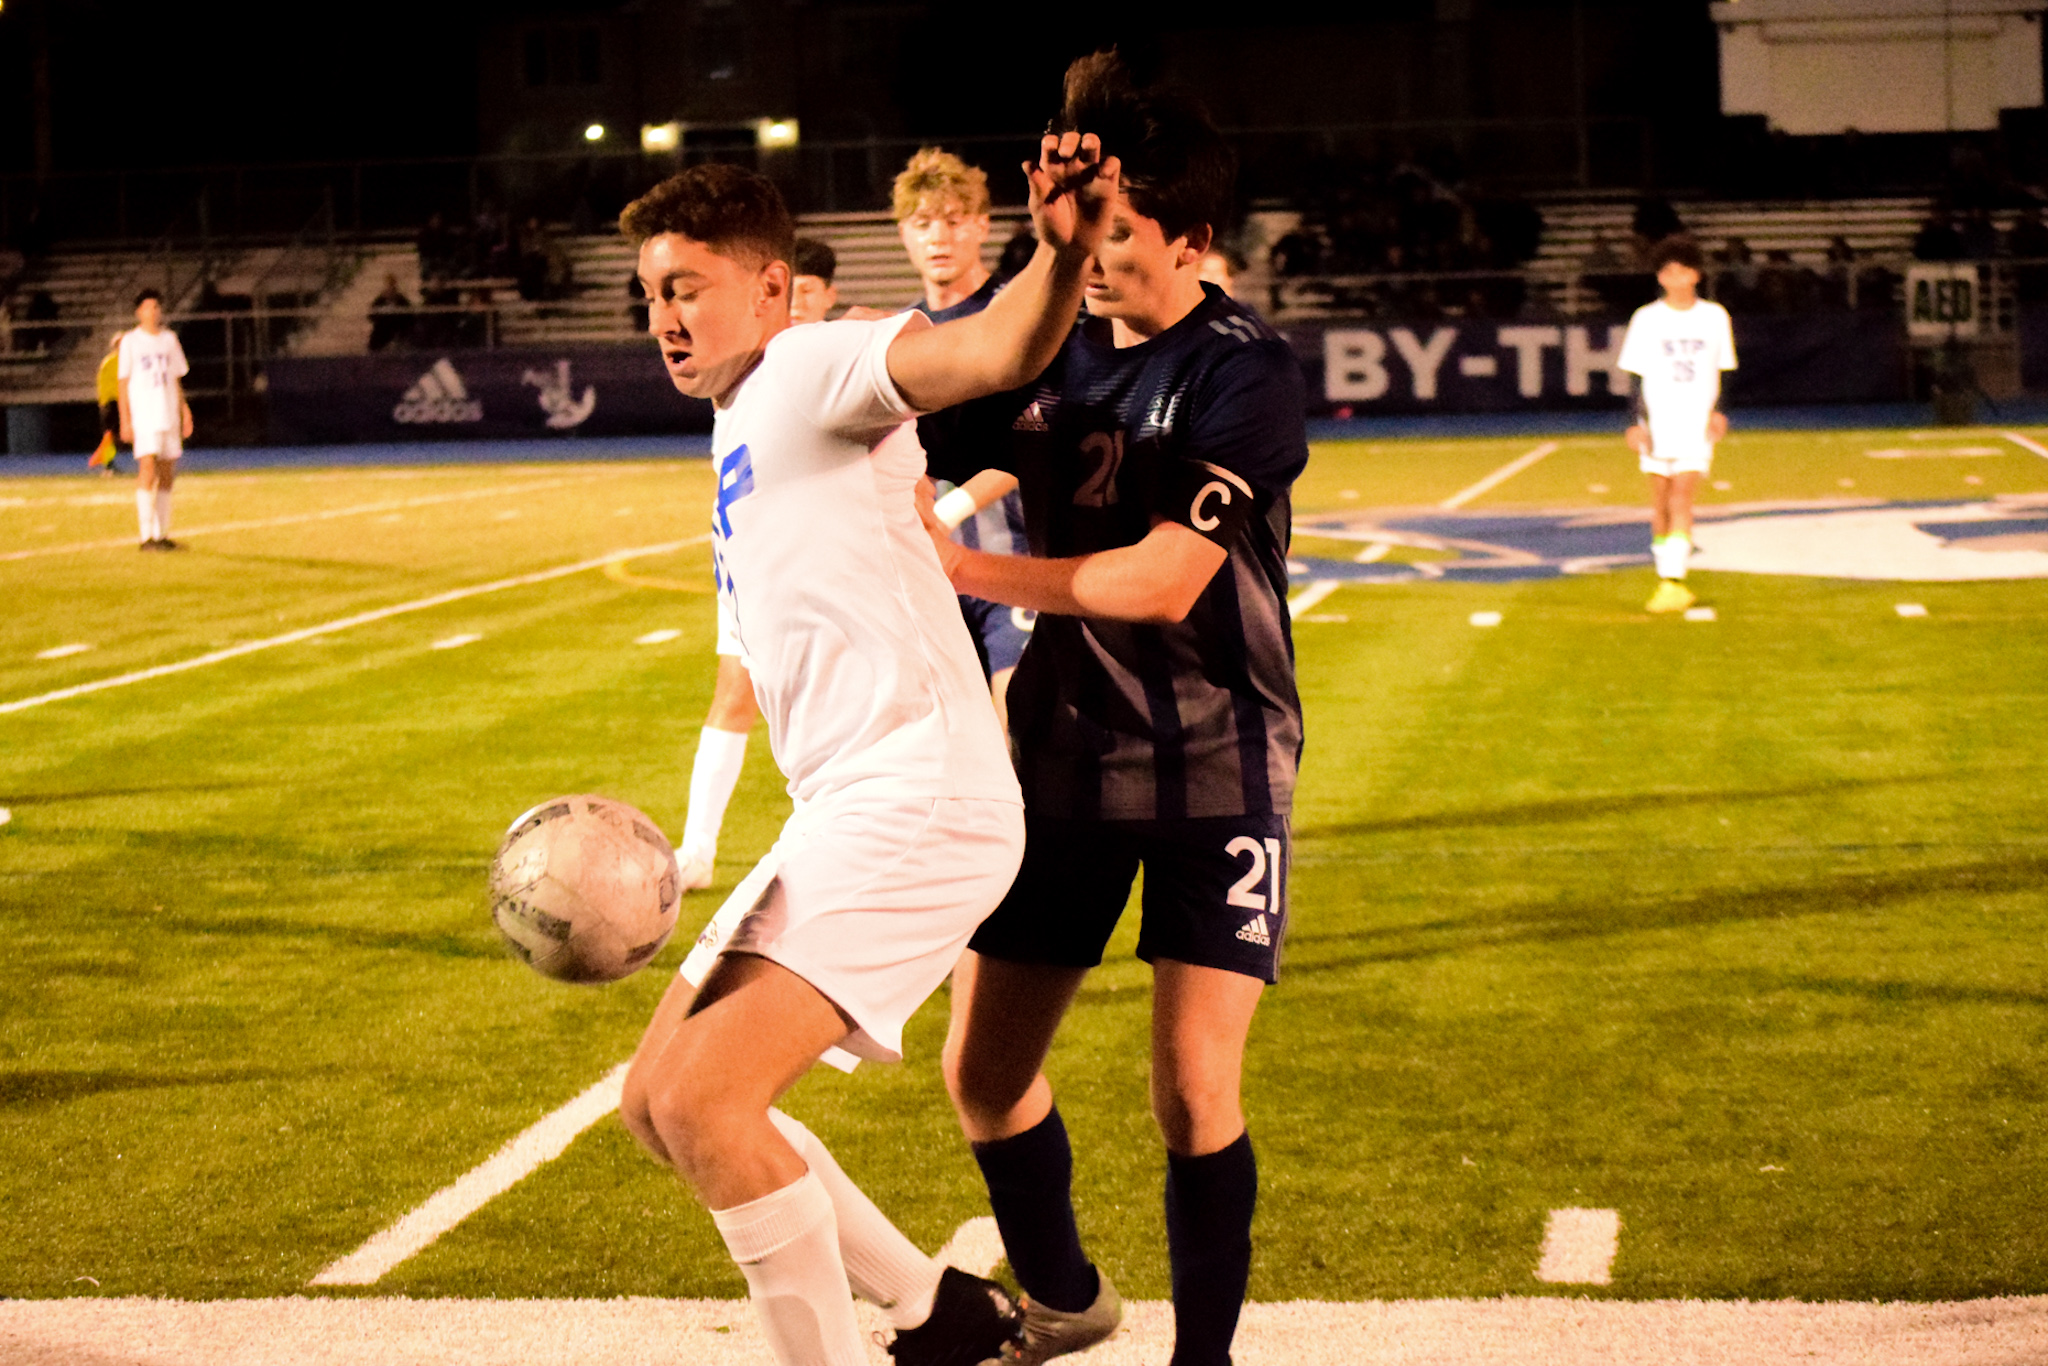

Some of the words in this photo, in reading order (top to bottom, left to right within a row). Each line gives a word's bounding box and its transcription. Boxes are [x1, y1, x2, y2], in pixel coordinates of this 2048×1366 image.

[1914, 280, 1972, 322] AED
[393, 400, 484, 423] adidas
[1012, 420, 1049, 433] adidas
[1190, 480, 1232, 533] C
[1224, 835, 1281, 915] 21
[1235, 929, 1271, 947] adidas
